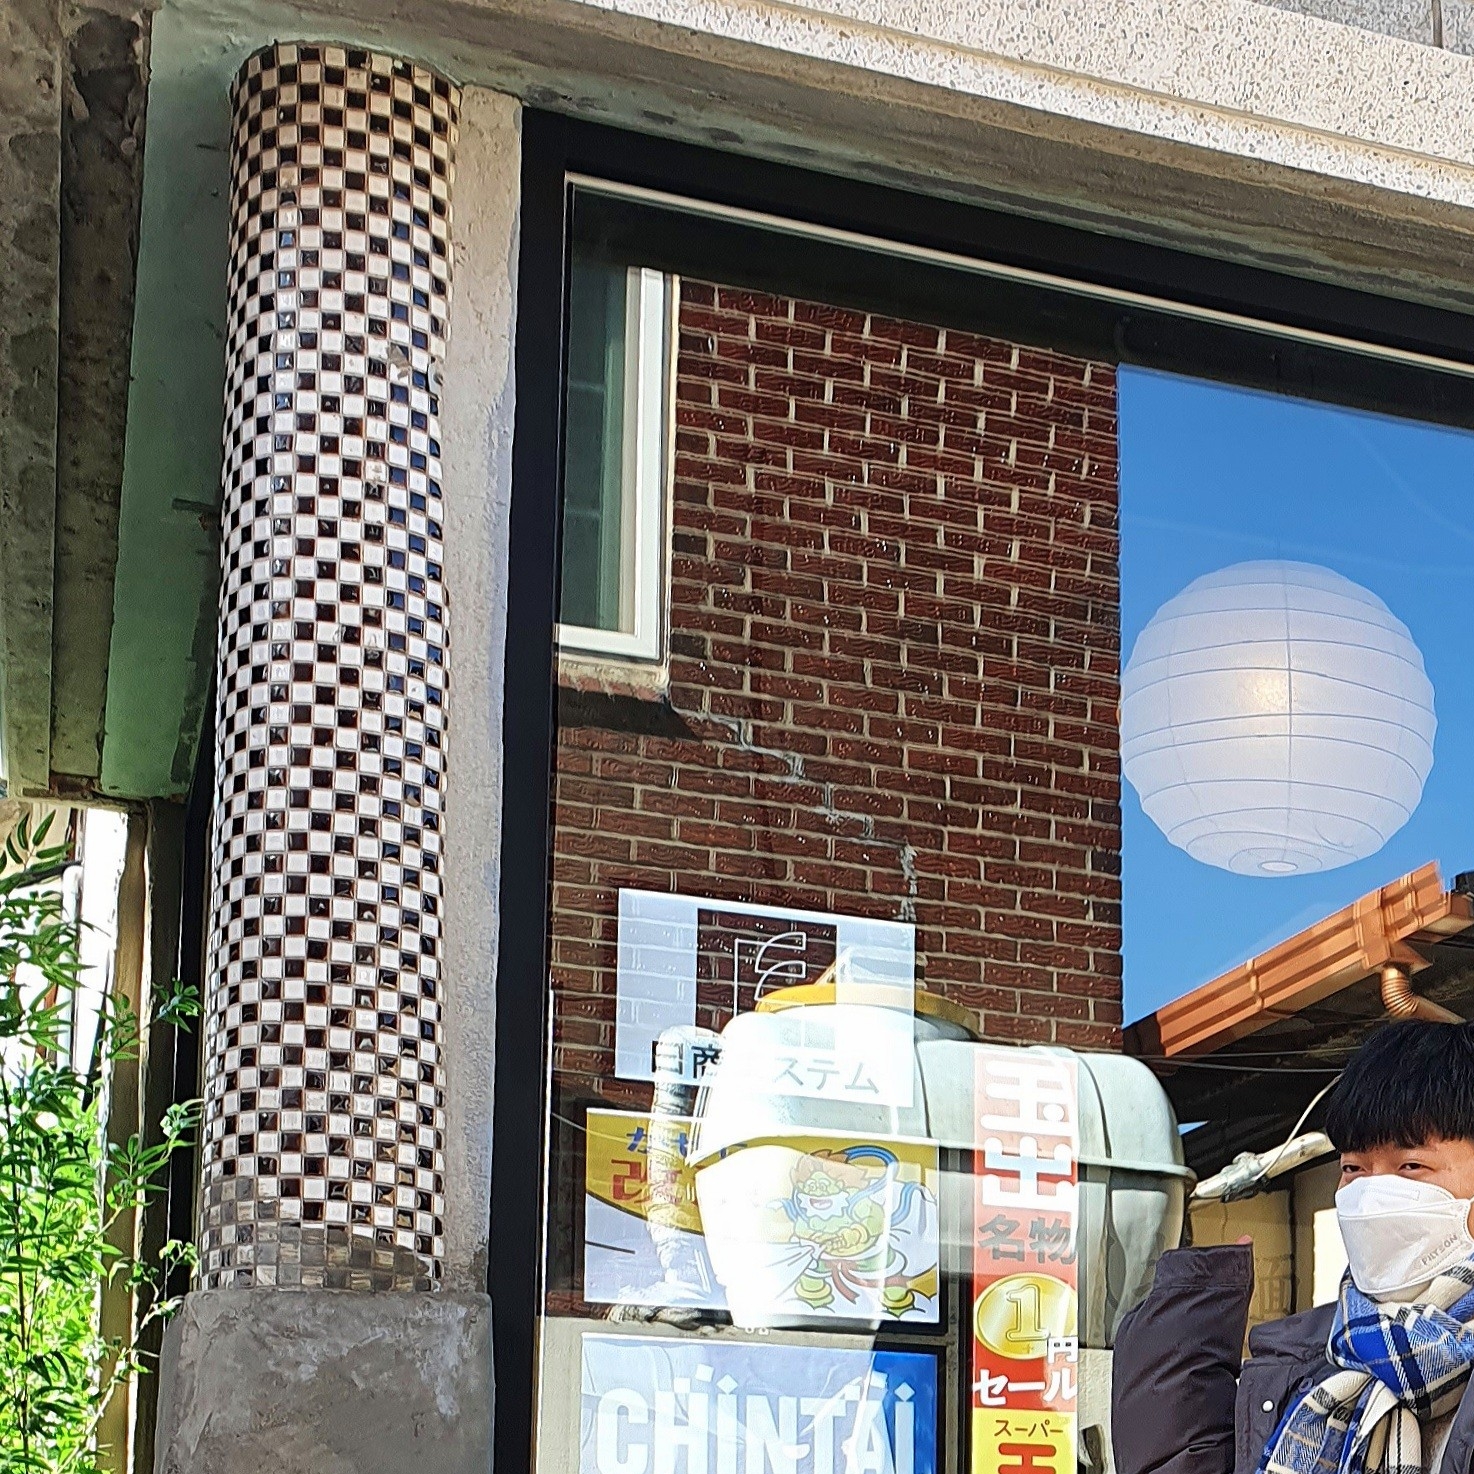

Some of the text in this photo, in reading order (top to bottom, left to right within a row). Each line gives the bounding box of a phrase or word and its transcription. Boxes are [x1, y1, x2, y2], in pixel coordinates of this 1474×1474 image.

[972, 1368, 1078, 1406] セール
[994, 1419, 1064, 1438] スーパー
